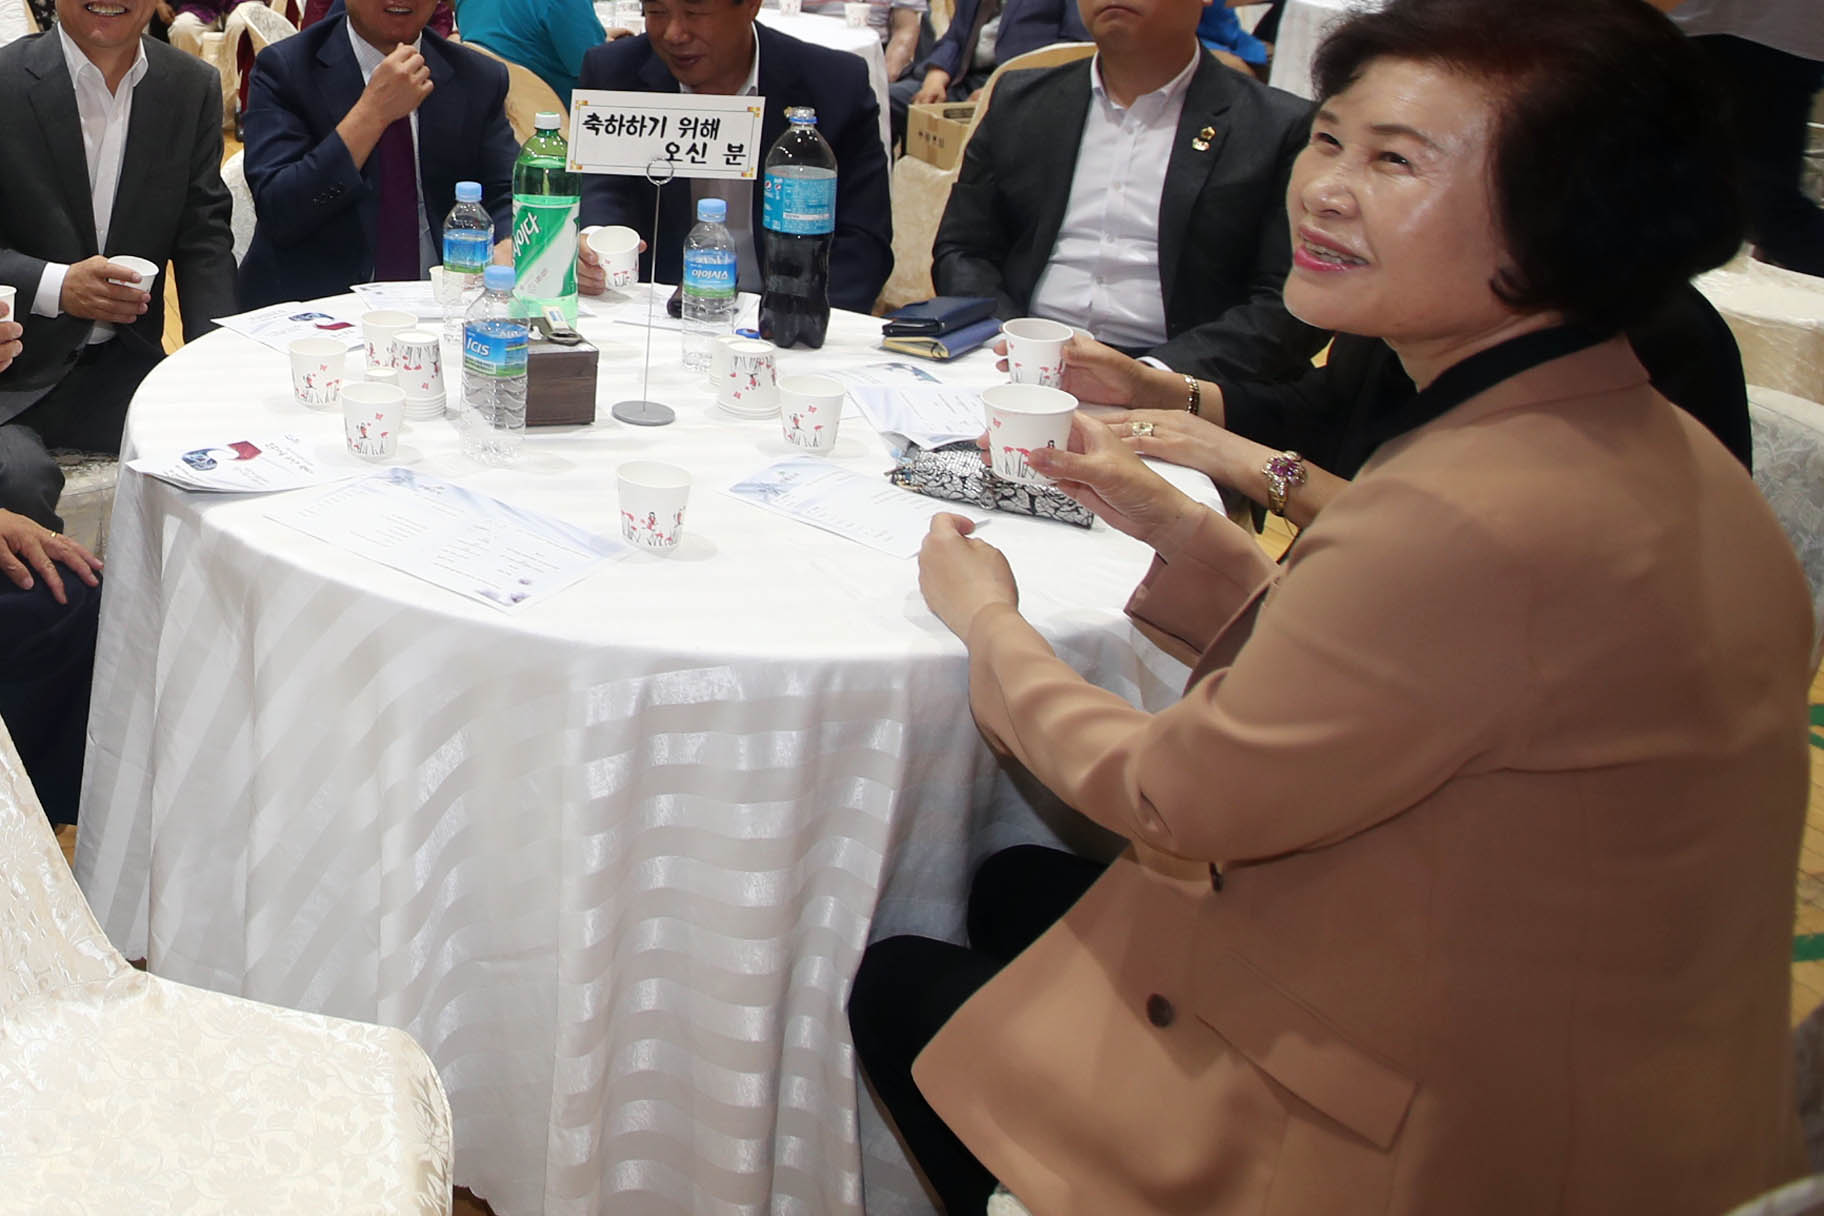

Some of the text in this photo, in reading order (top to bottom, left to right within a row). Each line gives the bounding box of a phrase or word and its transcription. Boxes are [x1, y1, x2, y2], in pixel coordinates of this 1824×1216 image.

[582, 112, 721, 141] 축하하기 위해
[665, 141, 746, 166] 오신 분
